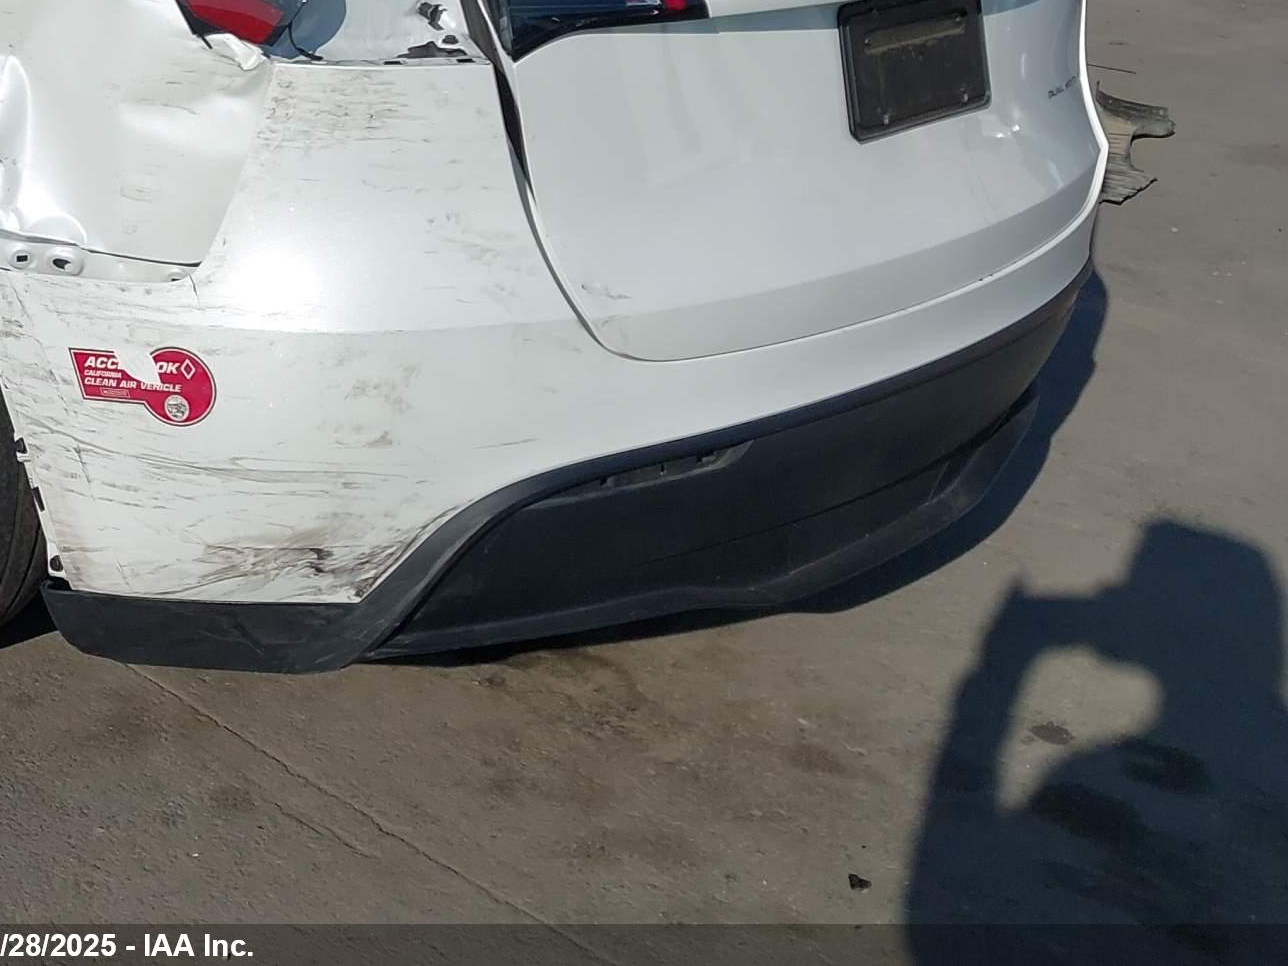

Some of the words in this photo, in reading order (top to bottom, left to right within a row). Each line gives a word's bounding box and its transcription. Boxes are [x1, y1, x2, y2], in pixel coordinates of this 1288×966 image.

[84, 355, 121, 370] ACC
[156, 361, 180, 375] OK
[84, 369, 122, 379] CALIFORNIA
[84, 377, 117, 388] CLEAN
[119, 378, 137, 389] AIR
[140, 381, 183, 393] VEHICLE
